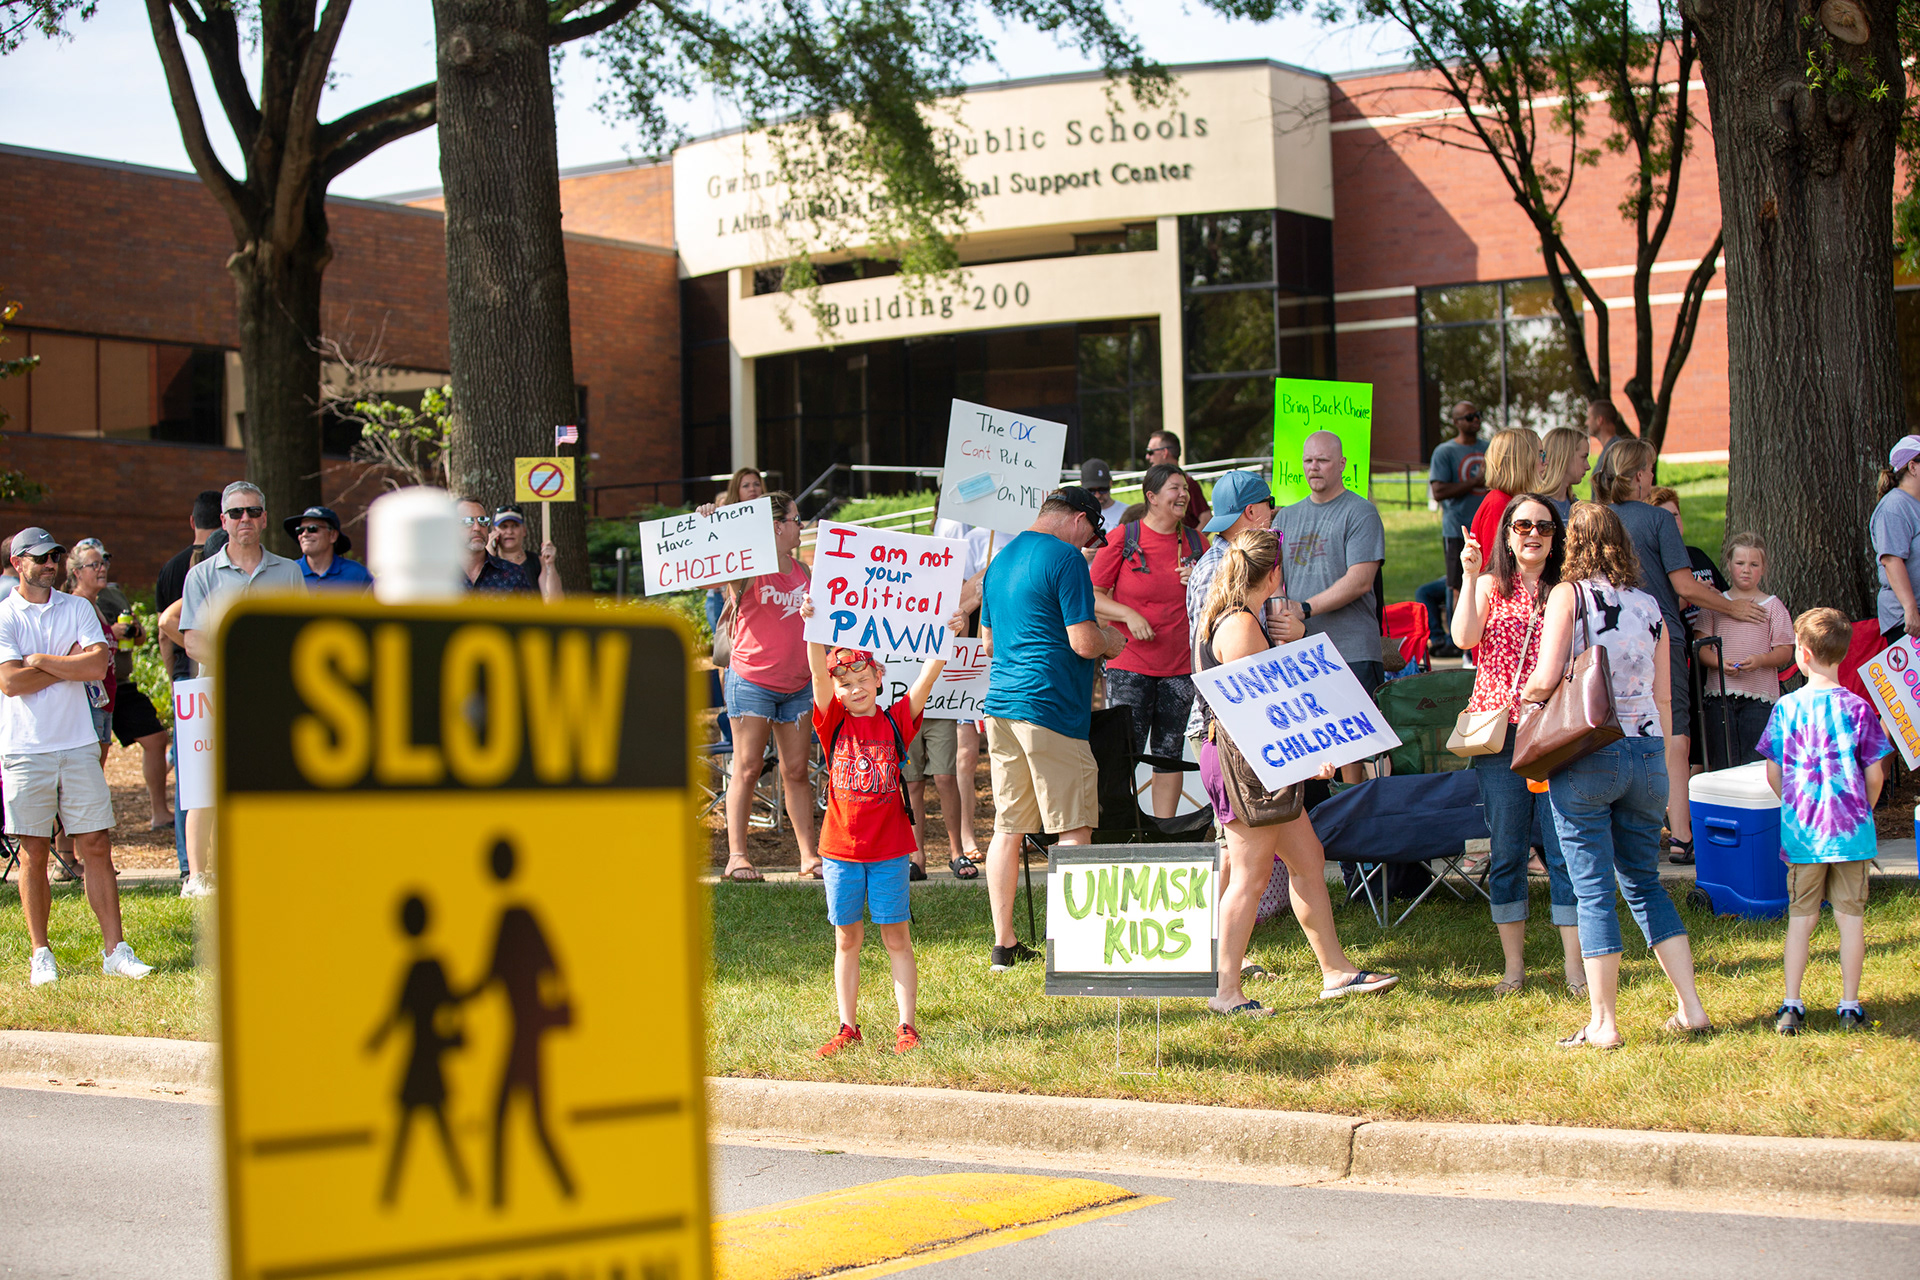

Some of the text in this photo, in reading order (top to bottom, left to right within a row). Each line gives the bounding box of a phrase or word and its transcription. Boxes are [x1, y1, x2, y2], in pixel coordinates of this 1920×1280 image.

[945, 126, 1046, 158] Public
[1066, 112, 1209, 145] Schools
[731, 212, 772, 234] Alvin
[1010, 168, 1102, 195] Support
[1111, 162, 1193, 184] Center
[826, 281, 1030, 327] Building 200
[976, 411, 1037, 444] The CDC
[1282, 393, 1371, 426] Bring Back Choice
[960, 439, 1037, 469] Can't Put a
[997, 486, 1016, 502] On
[660, 505, 755, 539] Let Them
[656, 531, 719, 555] Have A
[824, 528, 954, 568] I am not
[658, 548, 755, 588] CHOICE
[864, 566, 913, 586] your
[826, 576, 943, 616] Political
[829, 609, 945, 655] PAWN
[1213, 642, 1343, 705] UNMASK
[291, 618, 630, 788] SLOW
[1264, 691, 1329, 731] OUR
[1260, 711, 1378, 769] CHILDREN
[1063, 864, 1210, 921] UNMASK
[1103, 916, 1193, 966] KIDS
